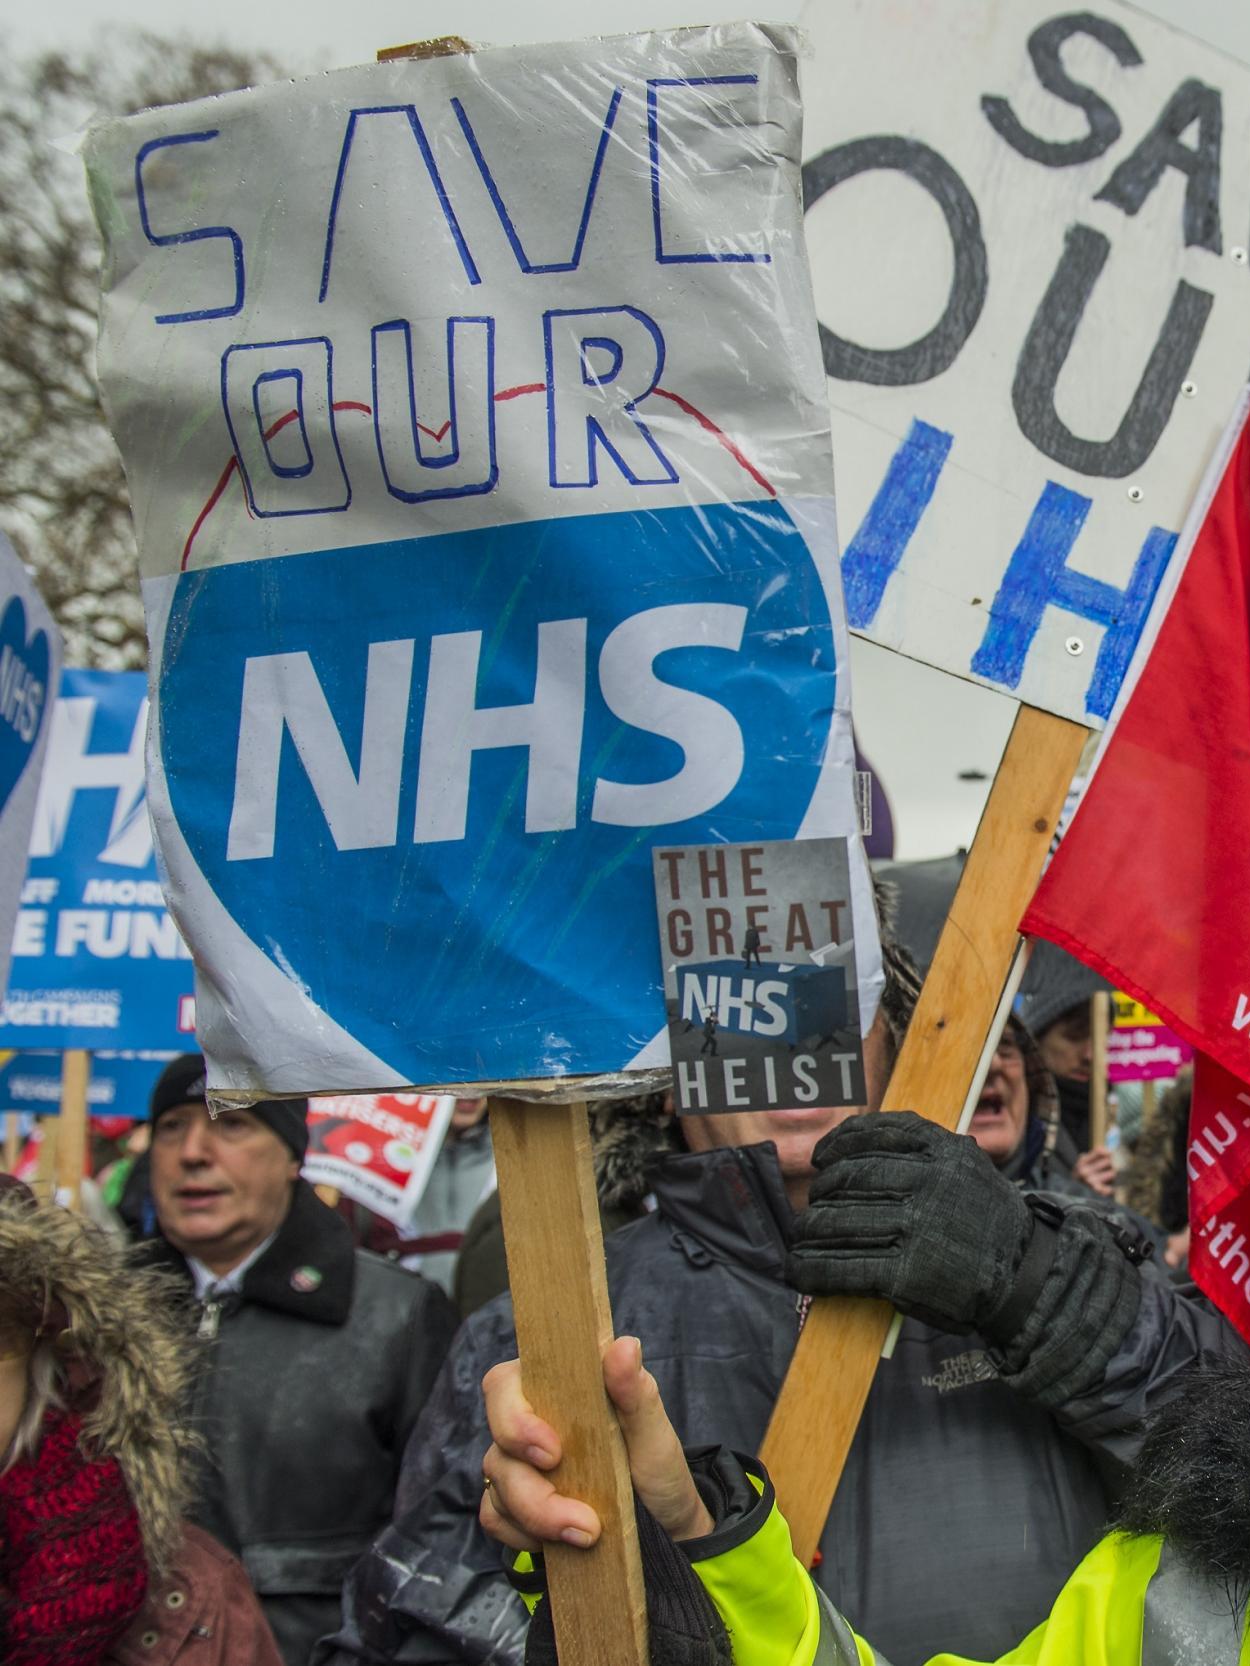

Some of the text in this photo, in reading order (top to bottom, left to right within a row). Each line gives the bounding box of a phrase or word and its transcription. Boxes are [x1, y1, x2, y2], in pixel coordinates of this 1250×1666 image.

[136, 75, 771, 324] SAVE
[221, 305, 680, 519] OUR
[226, 602, 748, 862] NHS
[660, 847, 767, 900] THE
[666, 901, 847, 958] GREAT
[682, 973, 789, 1037] NHS
[677, 1053, 858, 1109] HEIST
